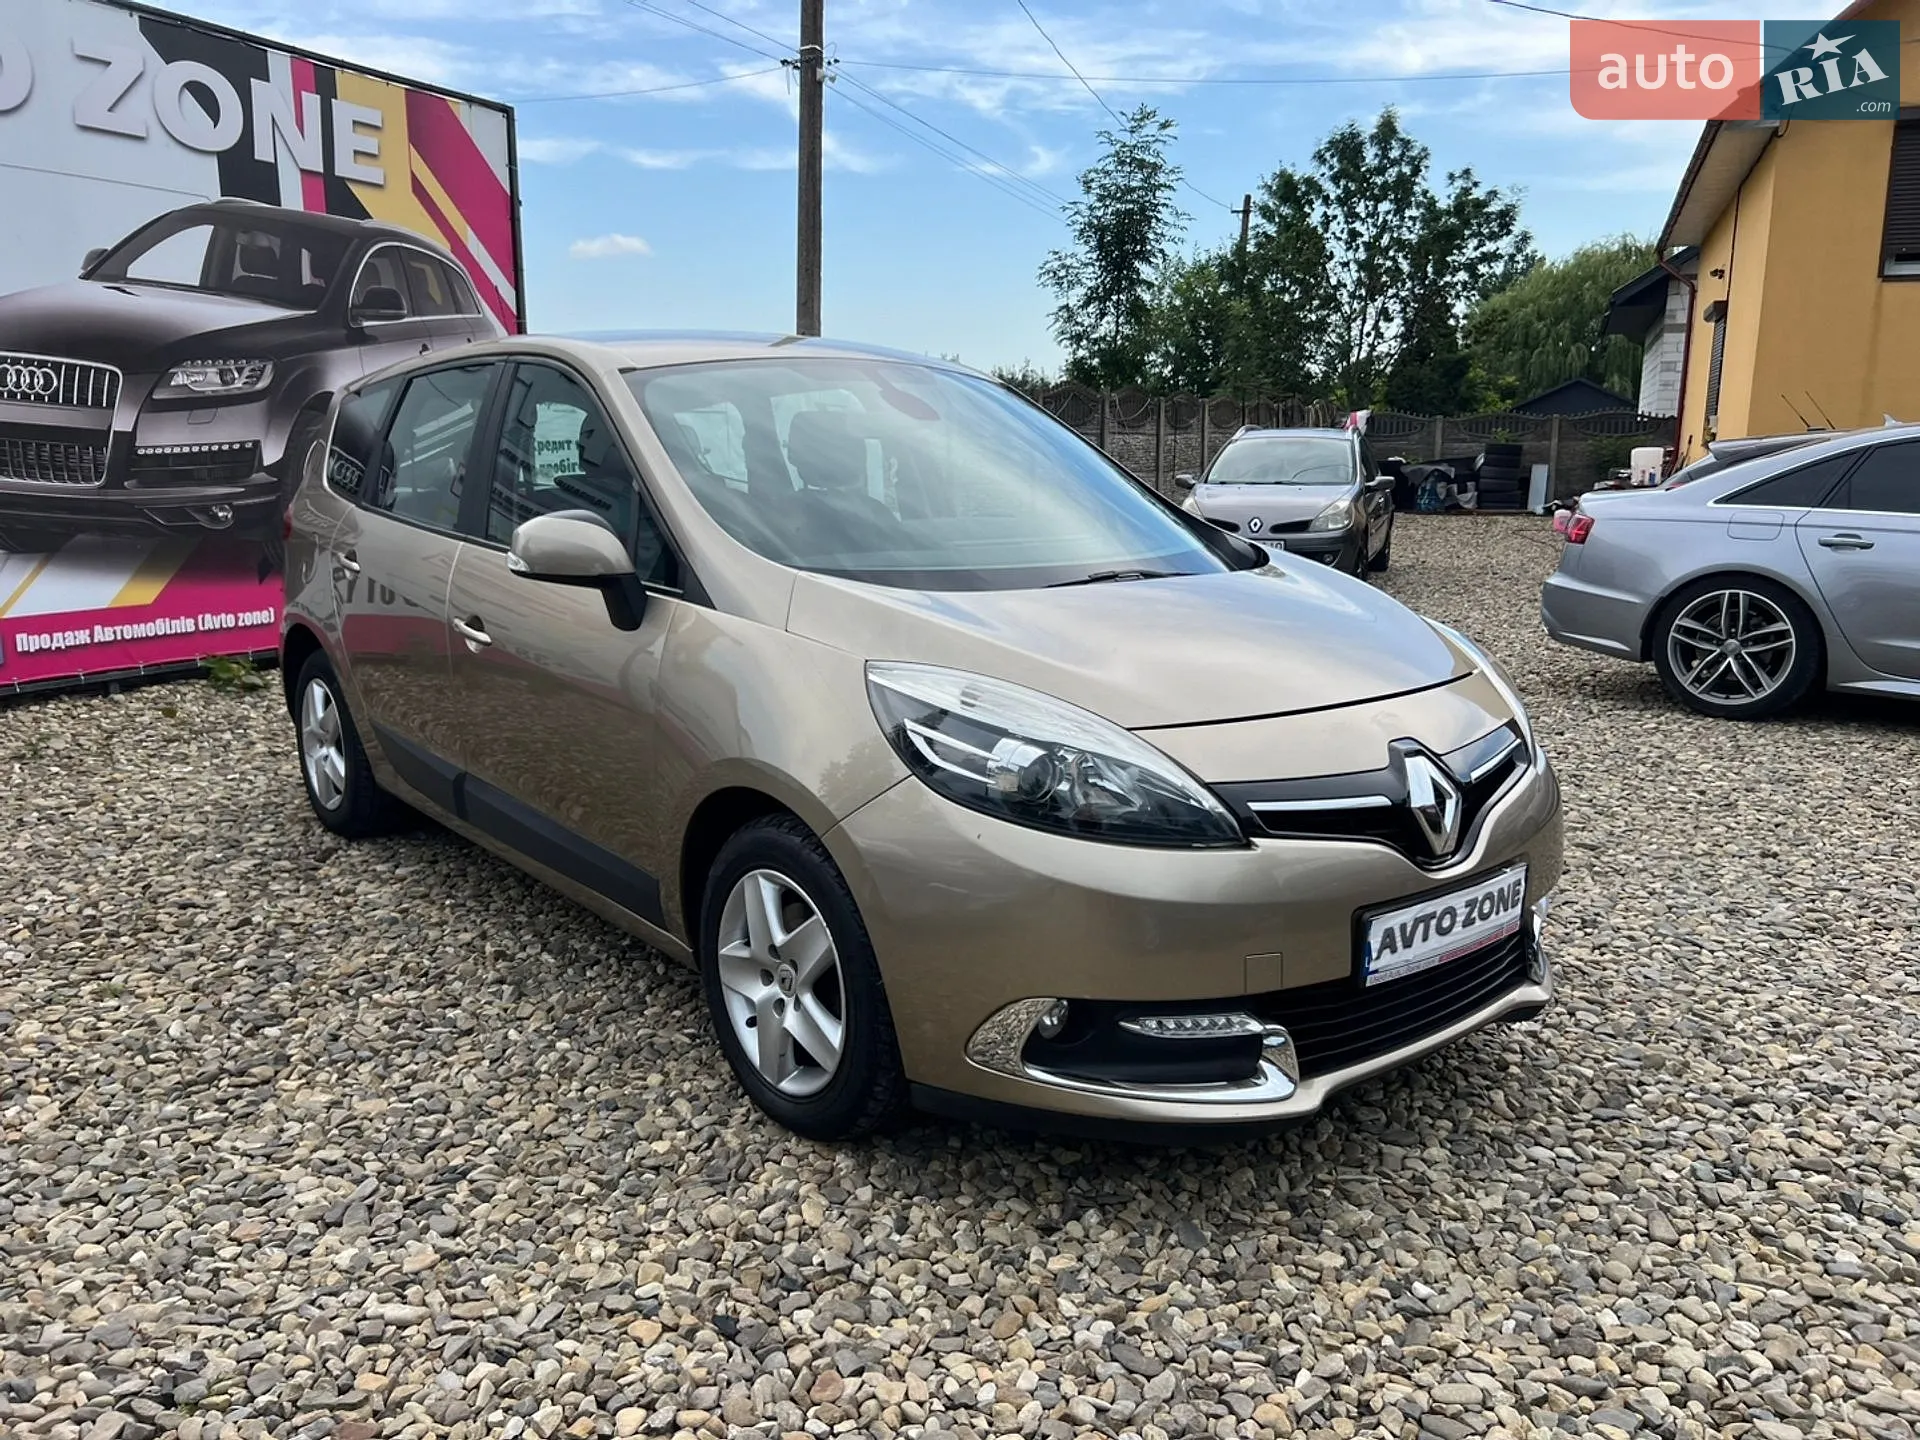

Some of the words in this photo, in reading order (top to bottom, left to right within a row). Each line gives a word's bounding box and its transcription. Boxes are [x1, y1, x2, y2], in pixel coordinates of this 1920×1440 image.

[71, 37, 385, 186] ZONE
[535, 439, 572, 455] редит
[16, 627, 91, 652] Продаж
[93, 616, 196, 643] Автомобілів
[198, 609, 236, 632] (Avto
[237, 606, 275, 627] zone)
[1374, 906, 1458, 961] AVTO
[1461, 878, 1523, 929] ZONE
